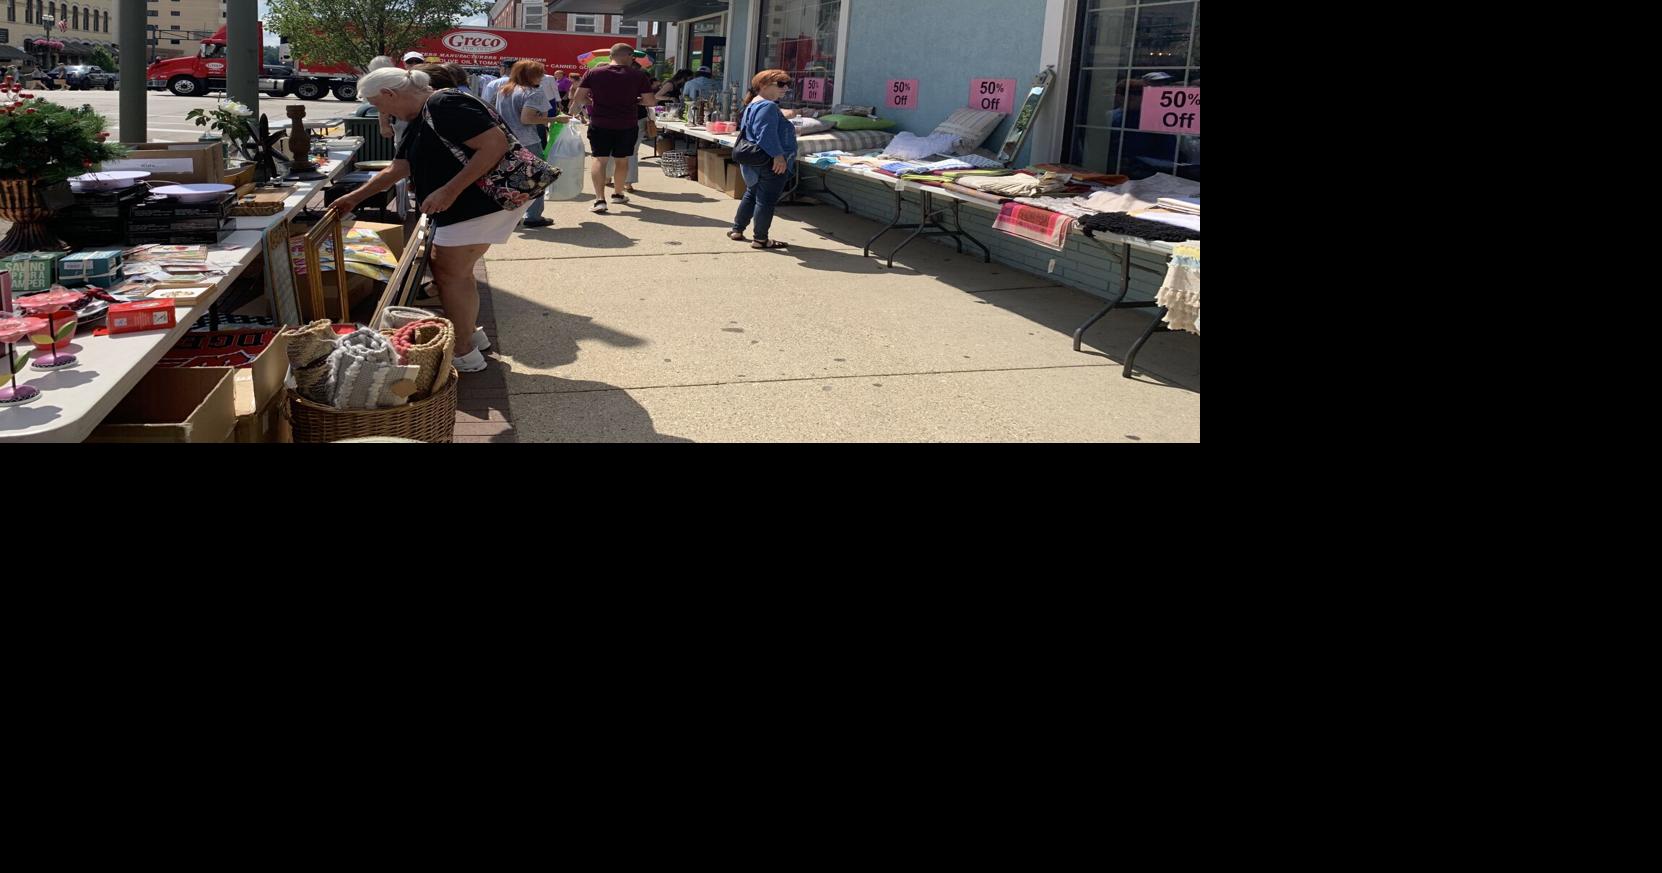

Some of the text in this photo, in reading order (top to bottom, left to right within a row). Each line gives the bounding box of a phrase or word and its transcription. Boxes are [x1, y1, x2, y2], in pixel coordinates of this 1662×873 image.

[448, 34, 501, 47] Greco
[893, 81, 911, 93] 50%
[980, 81, 1004, 94] 50%
[894, 95, 908, 105] Off
[981, 97, 1000, 110] Off
[1159, 90, 1200, 108] 50%
[1162, 112, 1196, 128] Off
[5, 261, 45, 272] SAVNG
[19, 271, 37, 280] FR
[12, 279, 45, 288] AMPER
